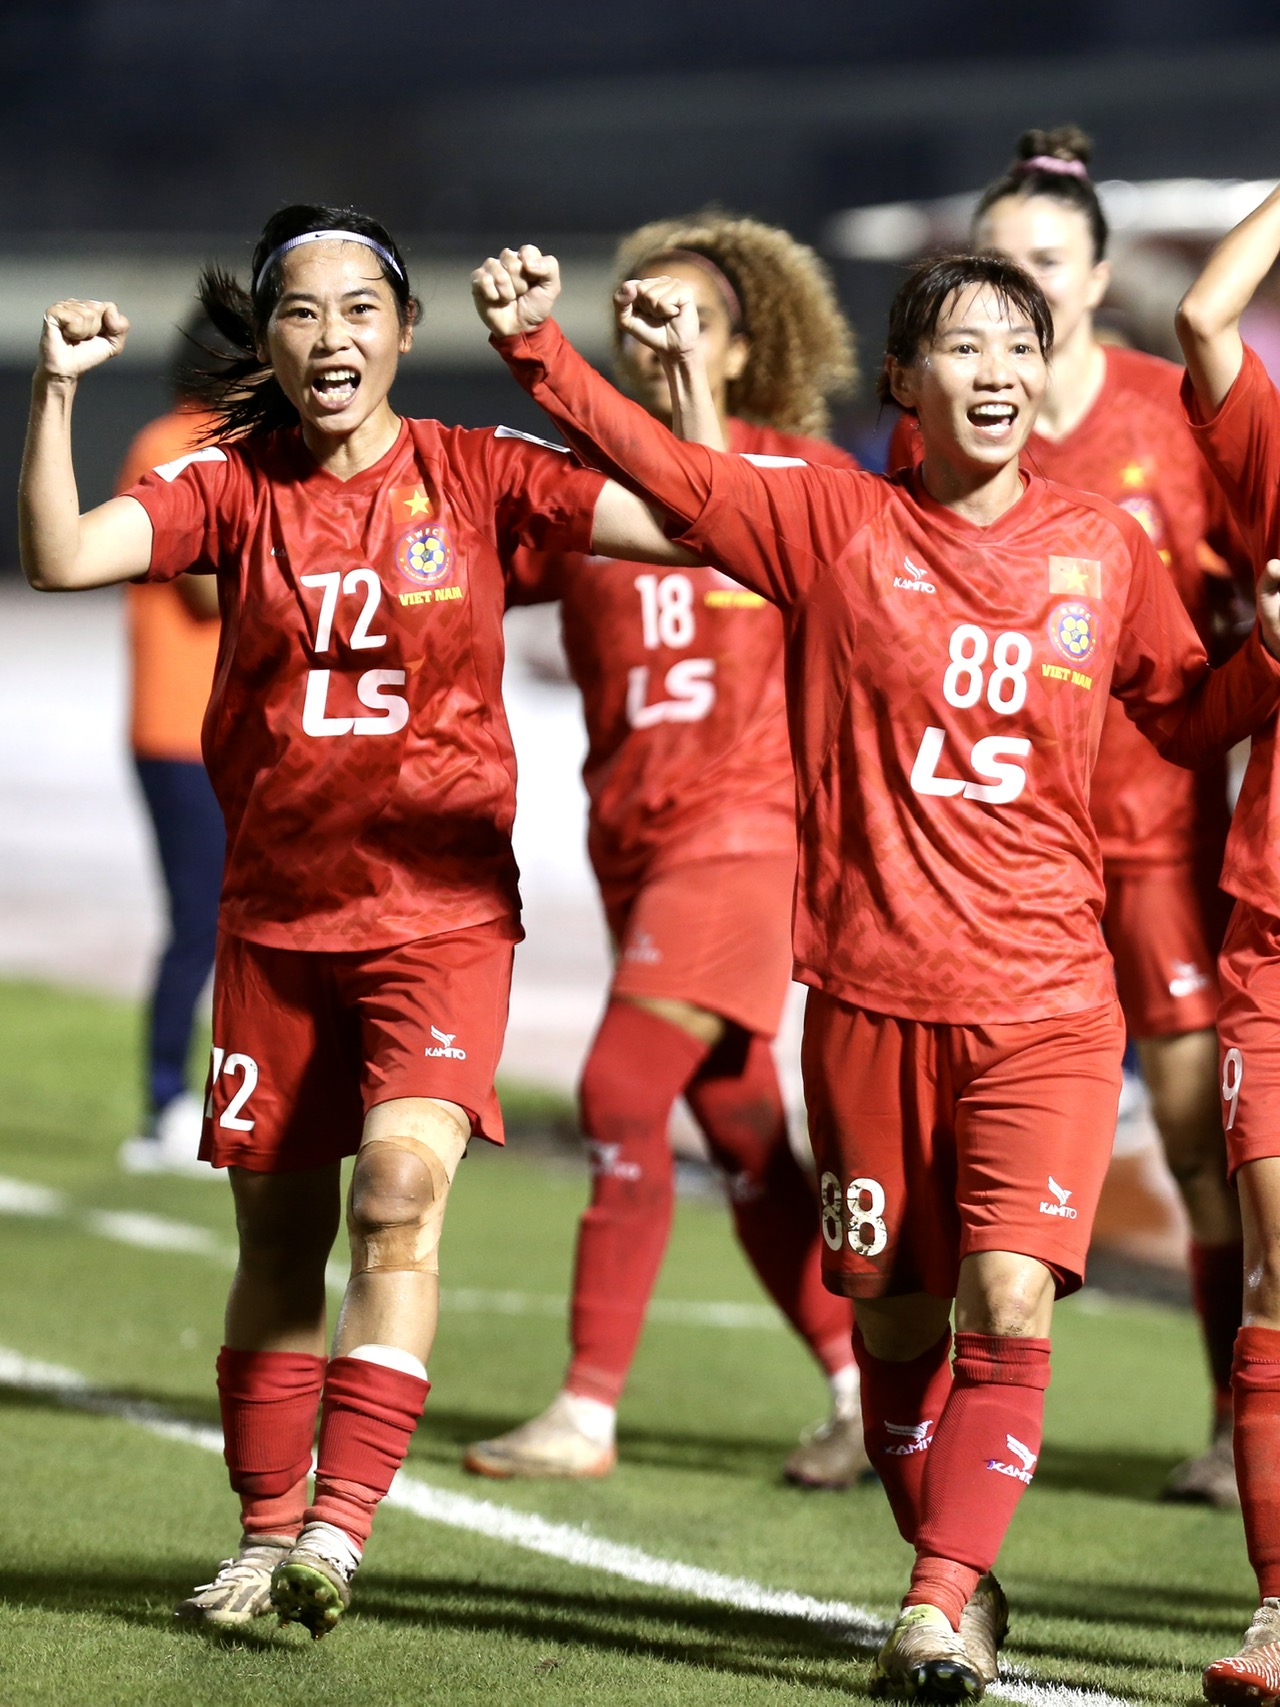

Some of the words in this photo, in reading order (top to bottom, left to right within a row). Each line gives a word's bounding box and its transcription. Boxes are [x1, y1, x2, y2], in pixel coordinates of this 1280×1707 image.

[300, 568, 387, 653] 72
[399, 590, 432, 606] VIET
[434, 586, 463, 601] NAM
[634, 573, 696, 650] 18
[893, 576, 937, 594] KAMITO
[302, 669, 410, 737] LS
[627, 659, 716, 729] LS
[943, 623, 1033, 715] 88
[1041, 663, 1071, 681] VIET
[1071, 671, 1093, 690] NAM
[909, 726, 1032, 805] LS
[424, 1047, 467, 1061] KAMITO
[1222, 1047, 1243, 1131] 9
[821, 1171, 888, 1257] 88
[1039, 1201, 1078, 1220] KAMITO
